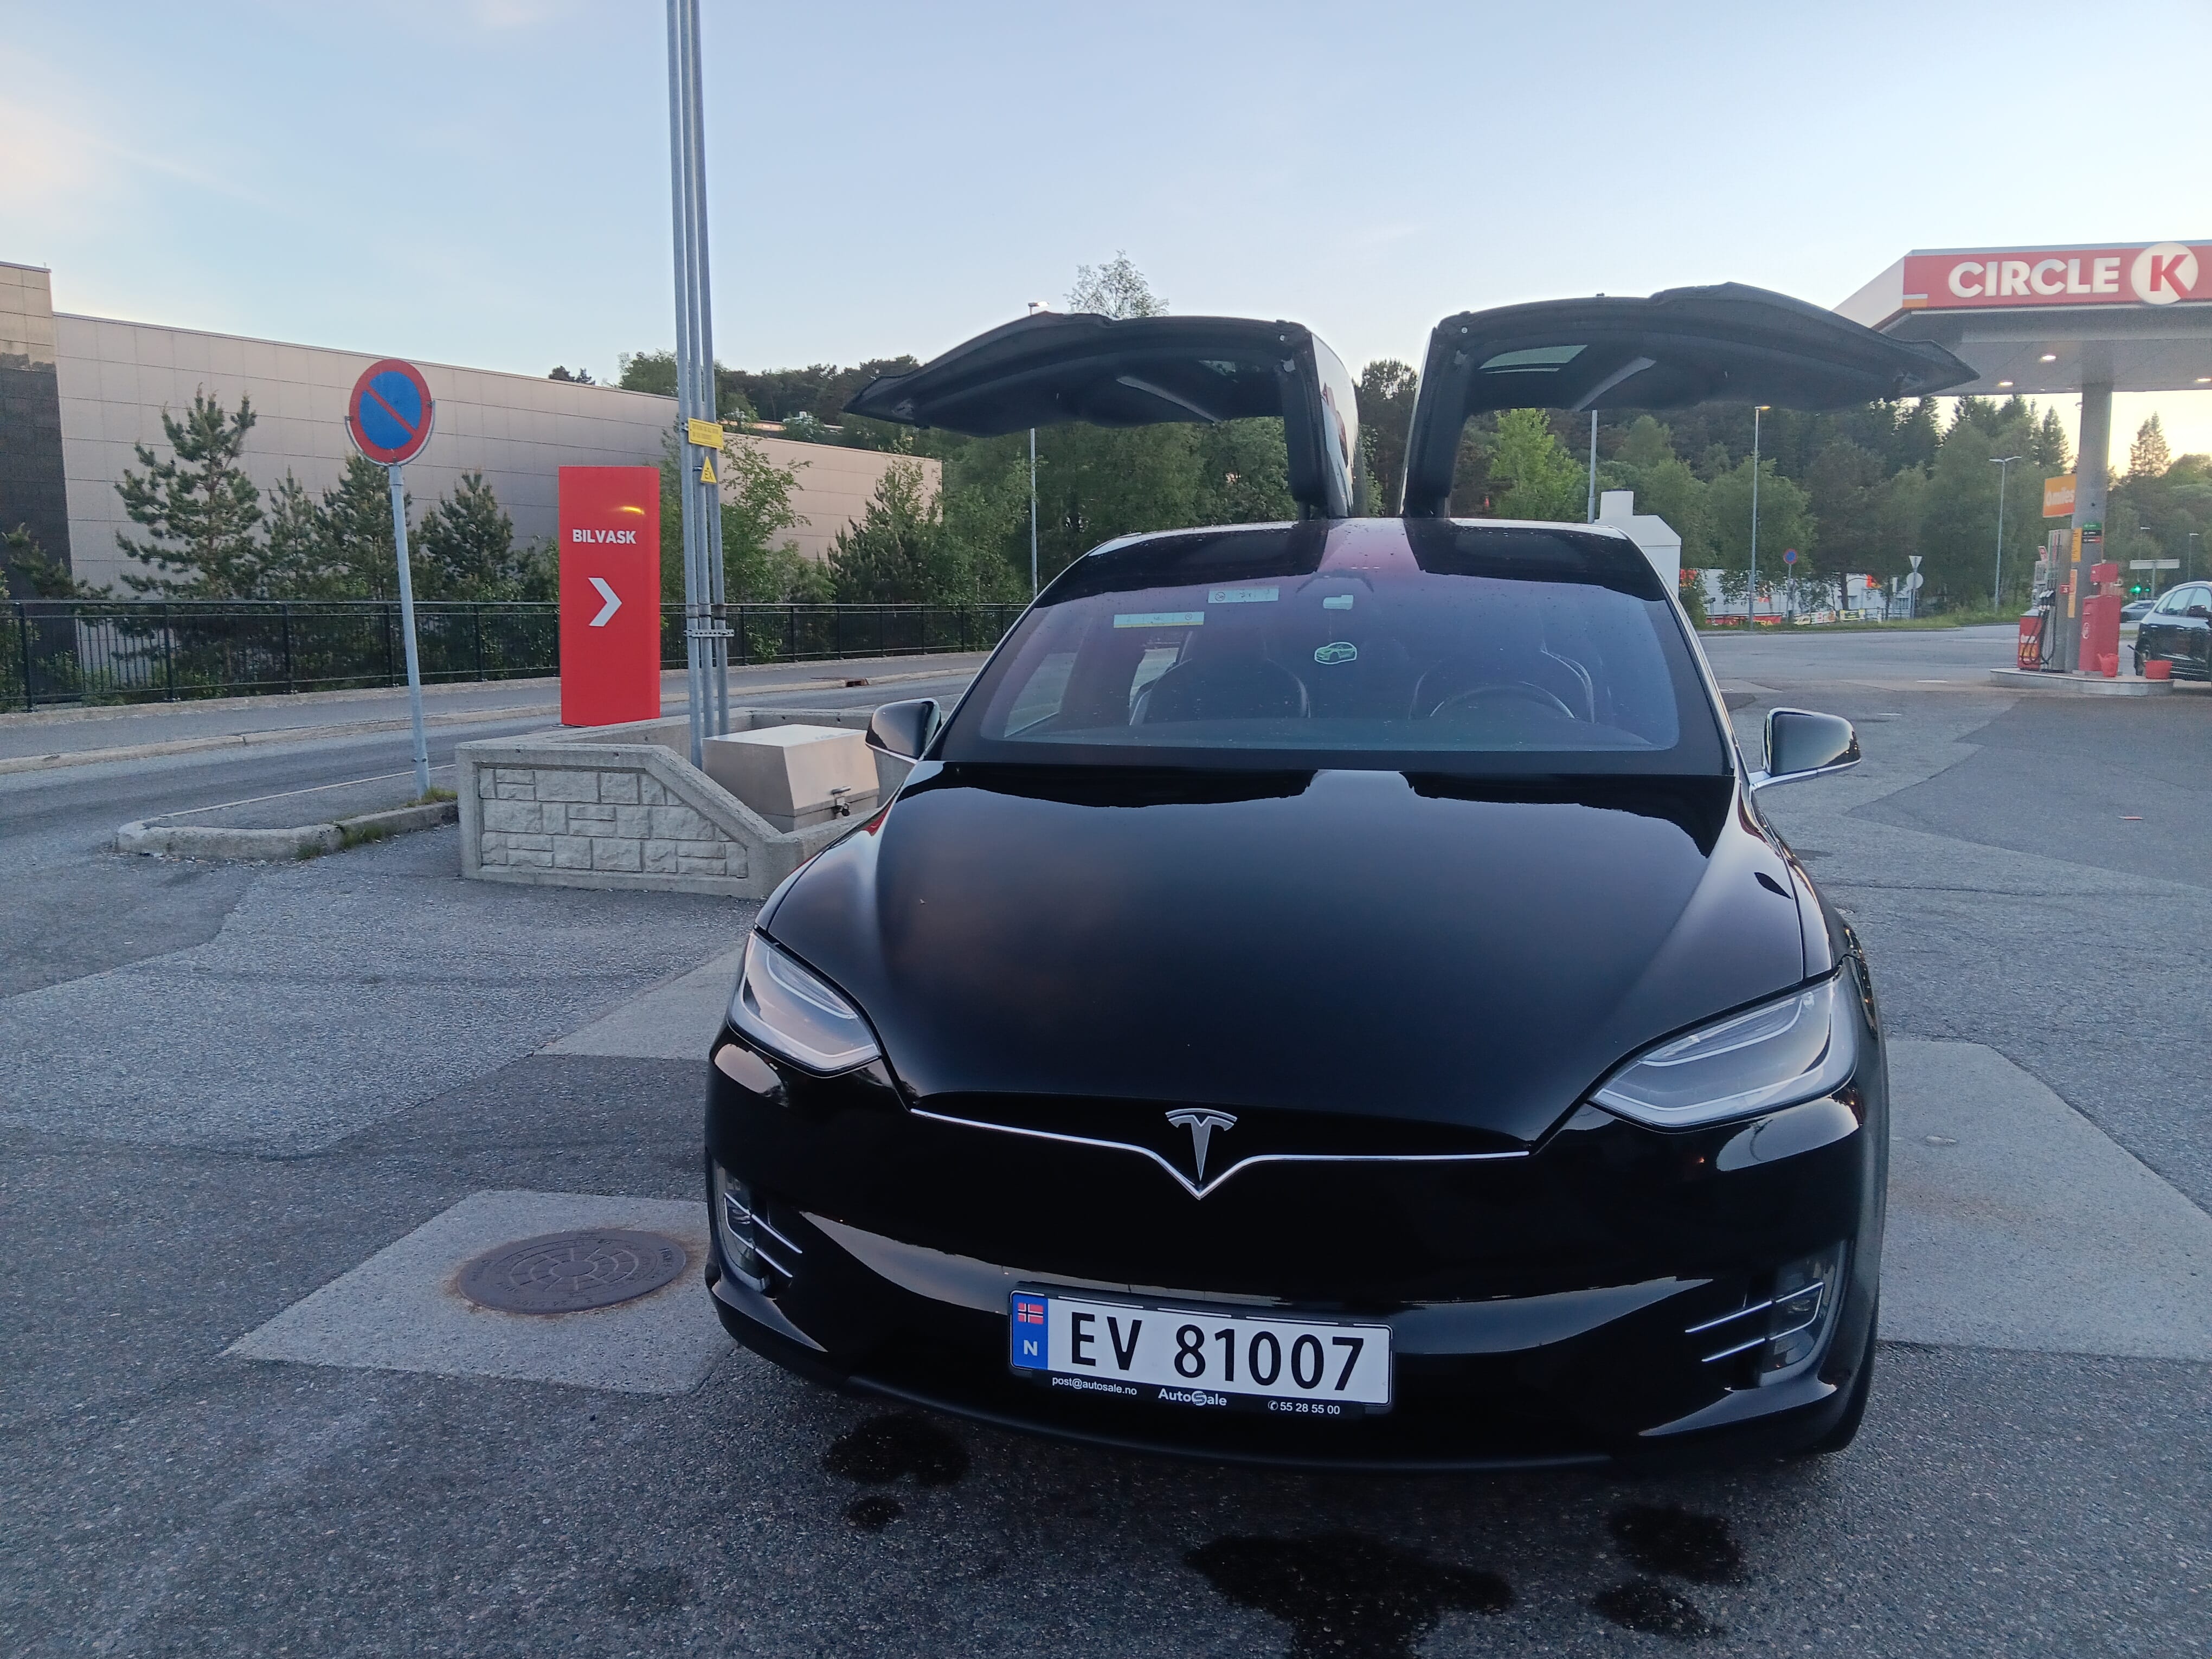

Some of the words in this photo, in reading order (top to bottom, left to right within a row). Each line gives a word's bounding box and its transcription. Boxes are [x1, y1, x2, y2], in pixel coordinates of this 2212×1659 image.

[1949, 257, 2120, 298] CIRCLE
[2150, 254, 2192, 300] K
[573, 529, 637, 544] BILVASK
[1023, 1340, 1038, 1356] N
[1071, 1311, 1142, 1371] EV
[1174, 1324, 1365, 1391] 81007
[1052, 1377, 1137, 1396] post@autosale.no
[1158, 1388, 1227, 1406] AutoSale
[1280, 1401, 1293, 1411] 55
[1296, 1403, 1309, 1412] 28
[1311, 1404, 1324, 1413] 55
[1327, 1405, 1341, 1414] 00
